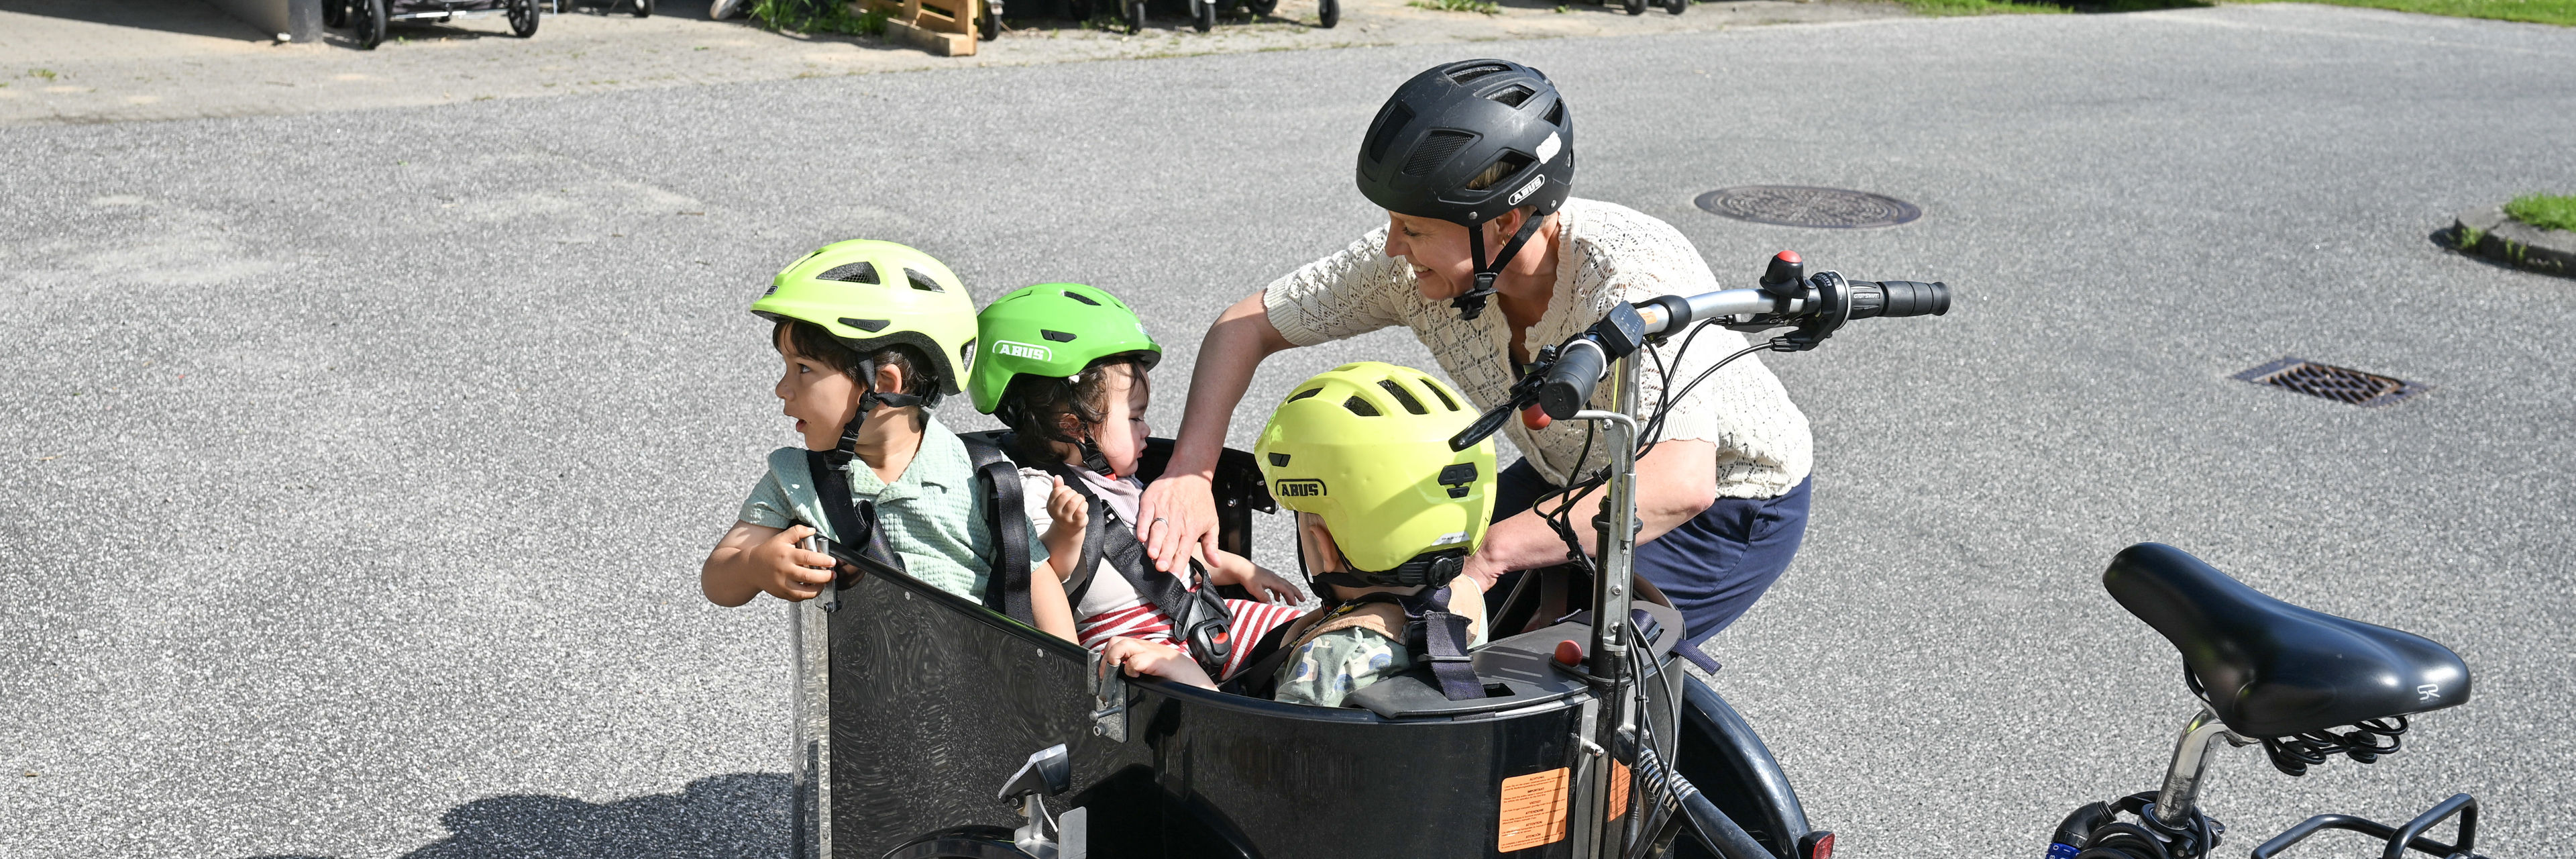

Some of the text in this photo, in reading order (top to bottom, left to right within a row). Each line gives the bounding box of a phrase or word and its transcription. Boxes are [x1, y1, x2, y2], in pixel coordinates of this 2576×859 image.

[1514, 177, 1542, 203] ABUS
[999, 344, 1044, 360] ABUS
[1281, 484, 1319, 497] ABUS
[2417, 684, 2440, 701] SR
